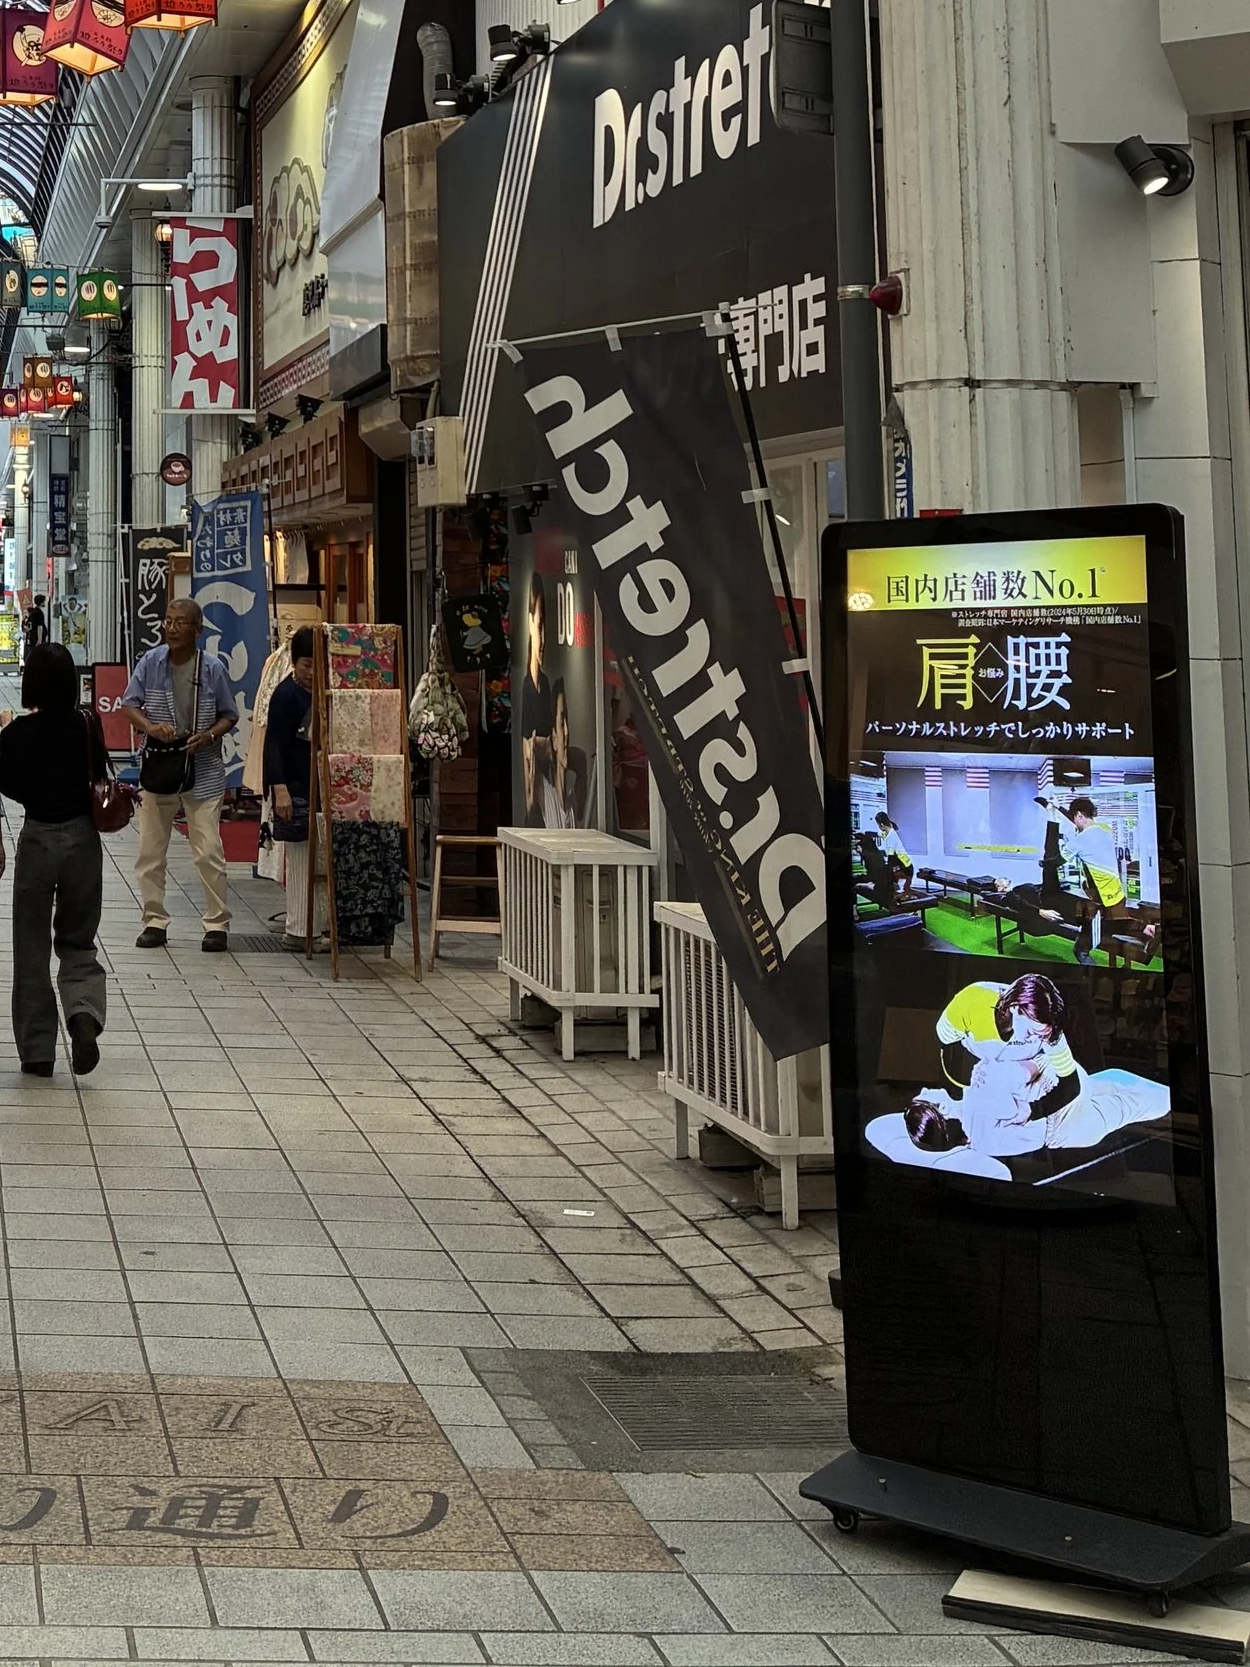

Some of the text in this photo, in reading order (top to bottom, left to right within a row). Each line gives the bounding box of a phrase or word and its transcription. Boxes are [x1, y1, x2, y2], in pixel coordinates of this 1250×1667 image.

[170, 218, 238, 410] らーめん
[137, 558, 169, 648] 豚とろ
[557, 581, 574, 647] DO
[886, 567, 1101, 604] 国内店舗数No.1
[98, 696, 122, 712] SA
[916, 634, 980, 711] 肩
[1002, 632, 1073, 711] 腰
[865, 720, 1135, 741] パーソナルストレッチでしっかりサポート
